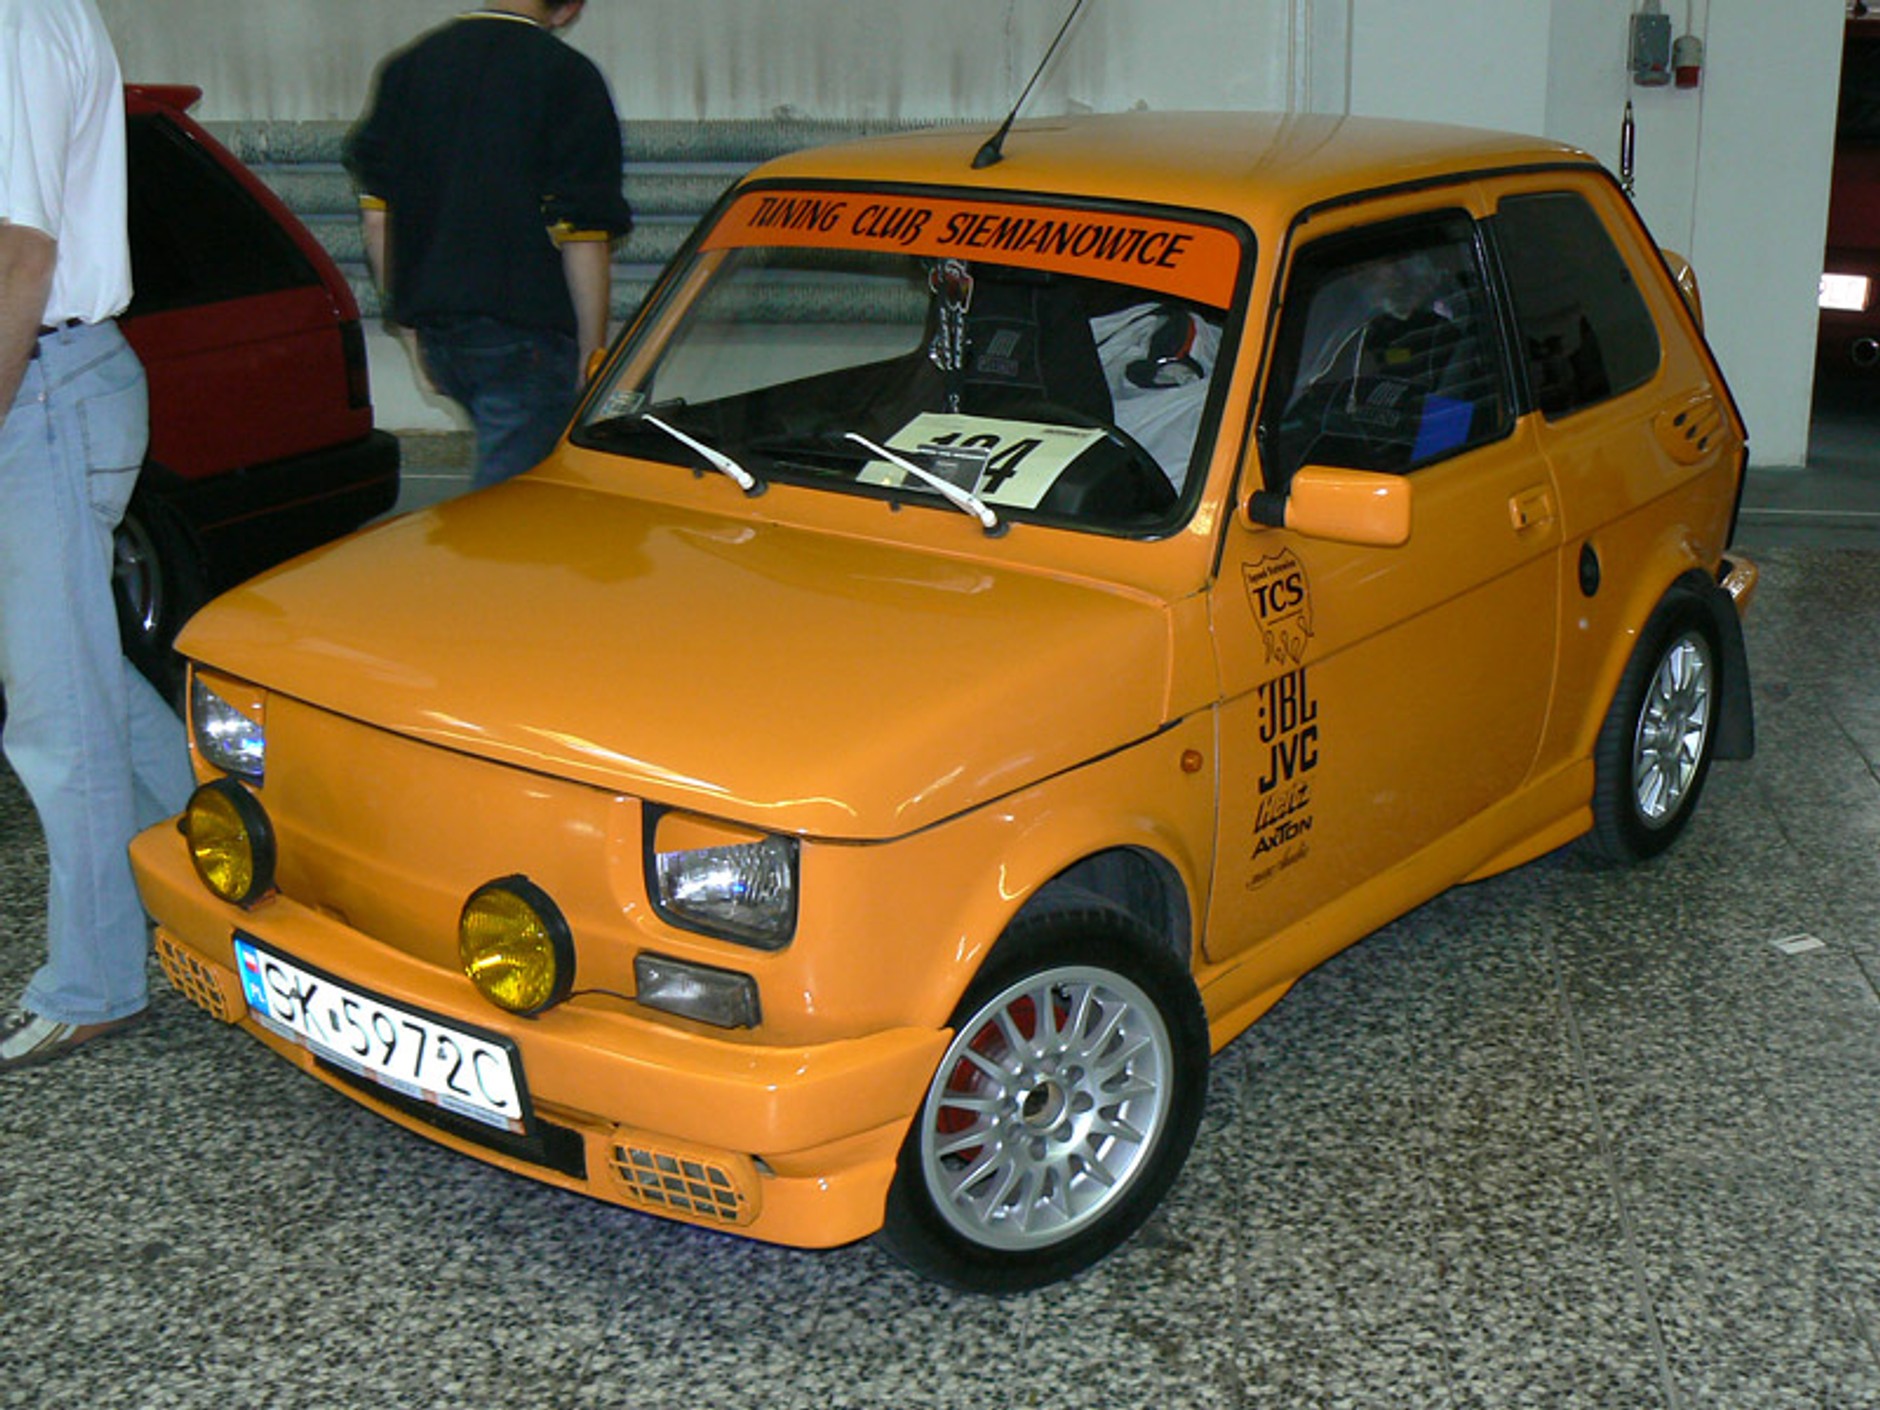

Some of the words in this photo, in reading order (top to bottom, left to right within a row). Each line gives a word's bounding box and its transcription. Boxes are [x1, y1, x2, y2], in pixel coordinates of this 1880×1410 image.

[746, 196, 847, 232] TUNING
[851, 203, 933, 246] CLUB
[937, 210, 1194, 270] SIEMIANOWICE
[1252, 572, 1304, 619] TCS
[1258, 667, 1318, 743] JBL
[1258, 724, 1318, 795] JVC
[341, 995, 508, 1109] 5972C
